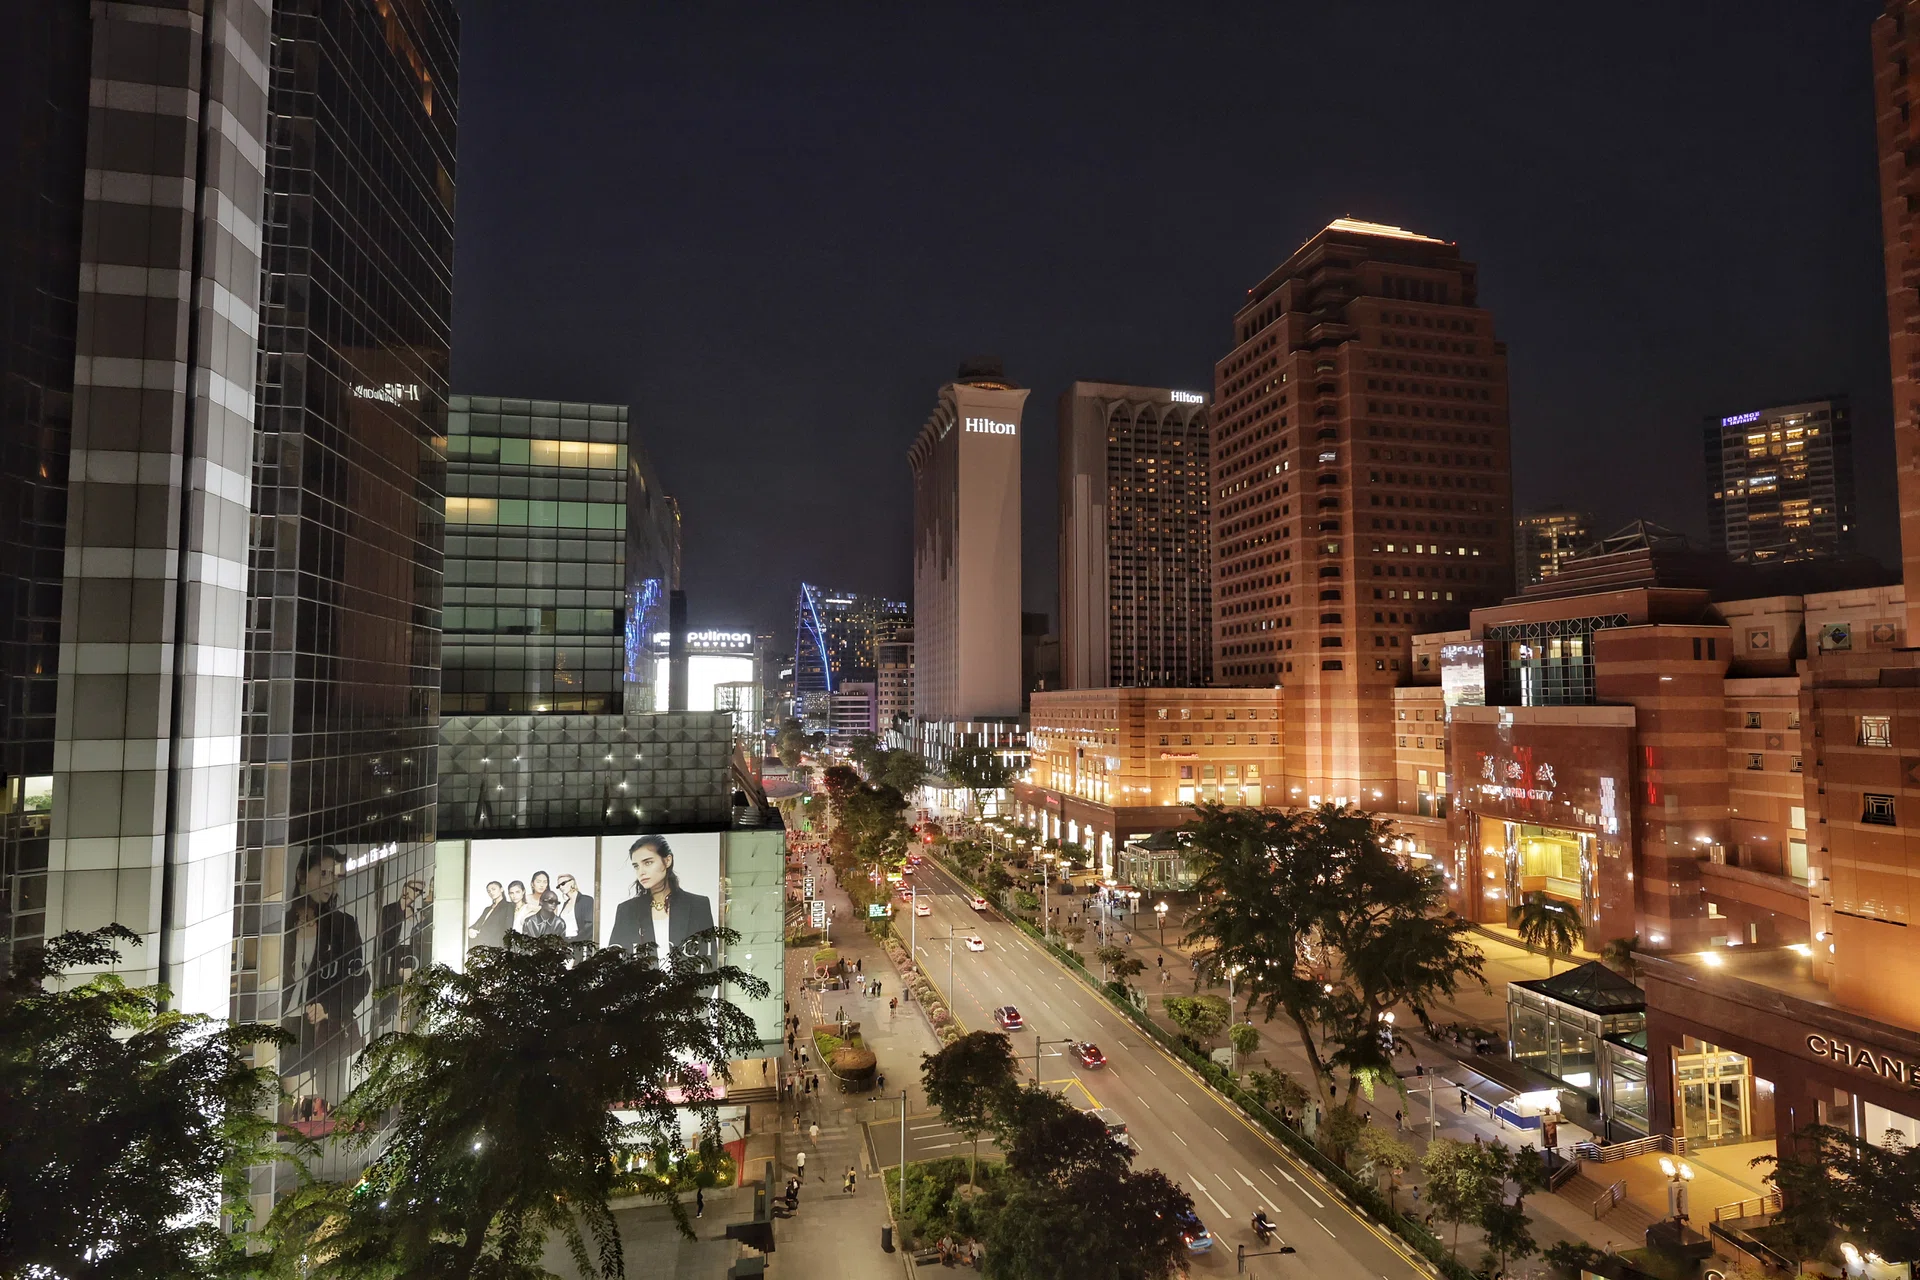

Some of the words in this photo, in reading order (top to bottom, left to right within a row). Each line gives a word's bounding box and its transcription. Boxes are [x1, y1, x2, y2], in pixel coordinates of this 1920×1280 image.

[1170, 390, 1204, 404] Hilton
[965, 417, 1016, 435] Hilton
[687, 631, 751, 645] pullman
